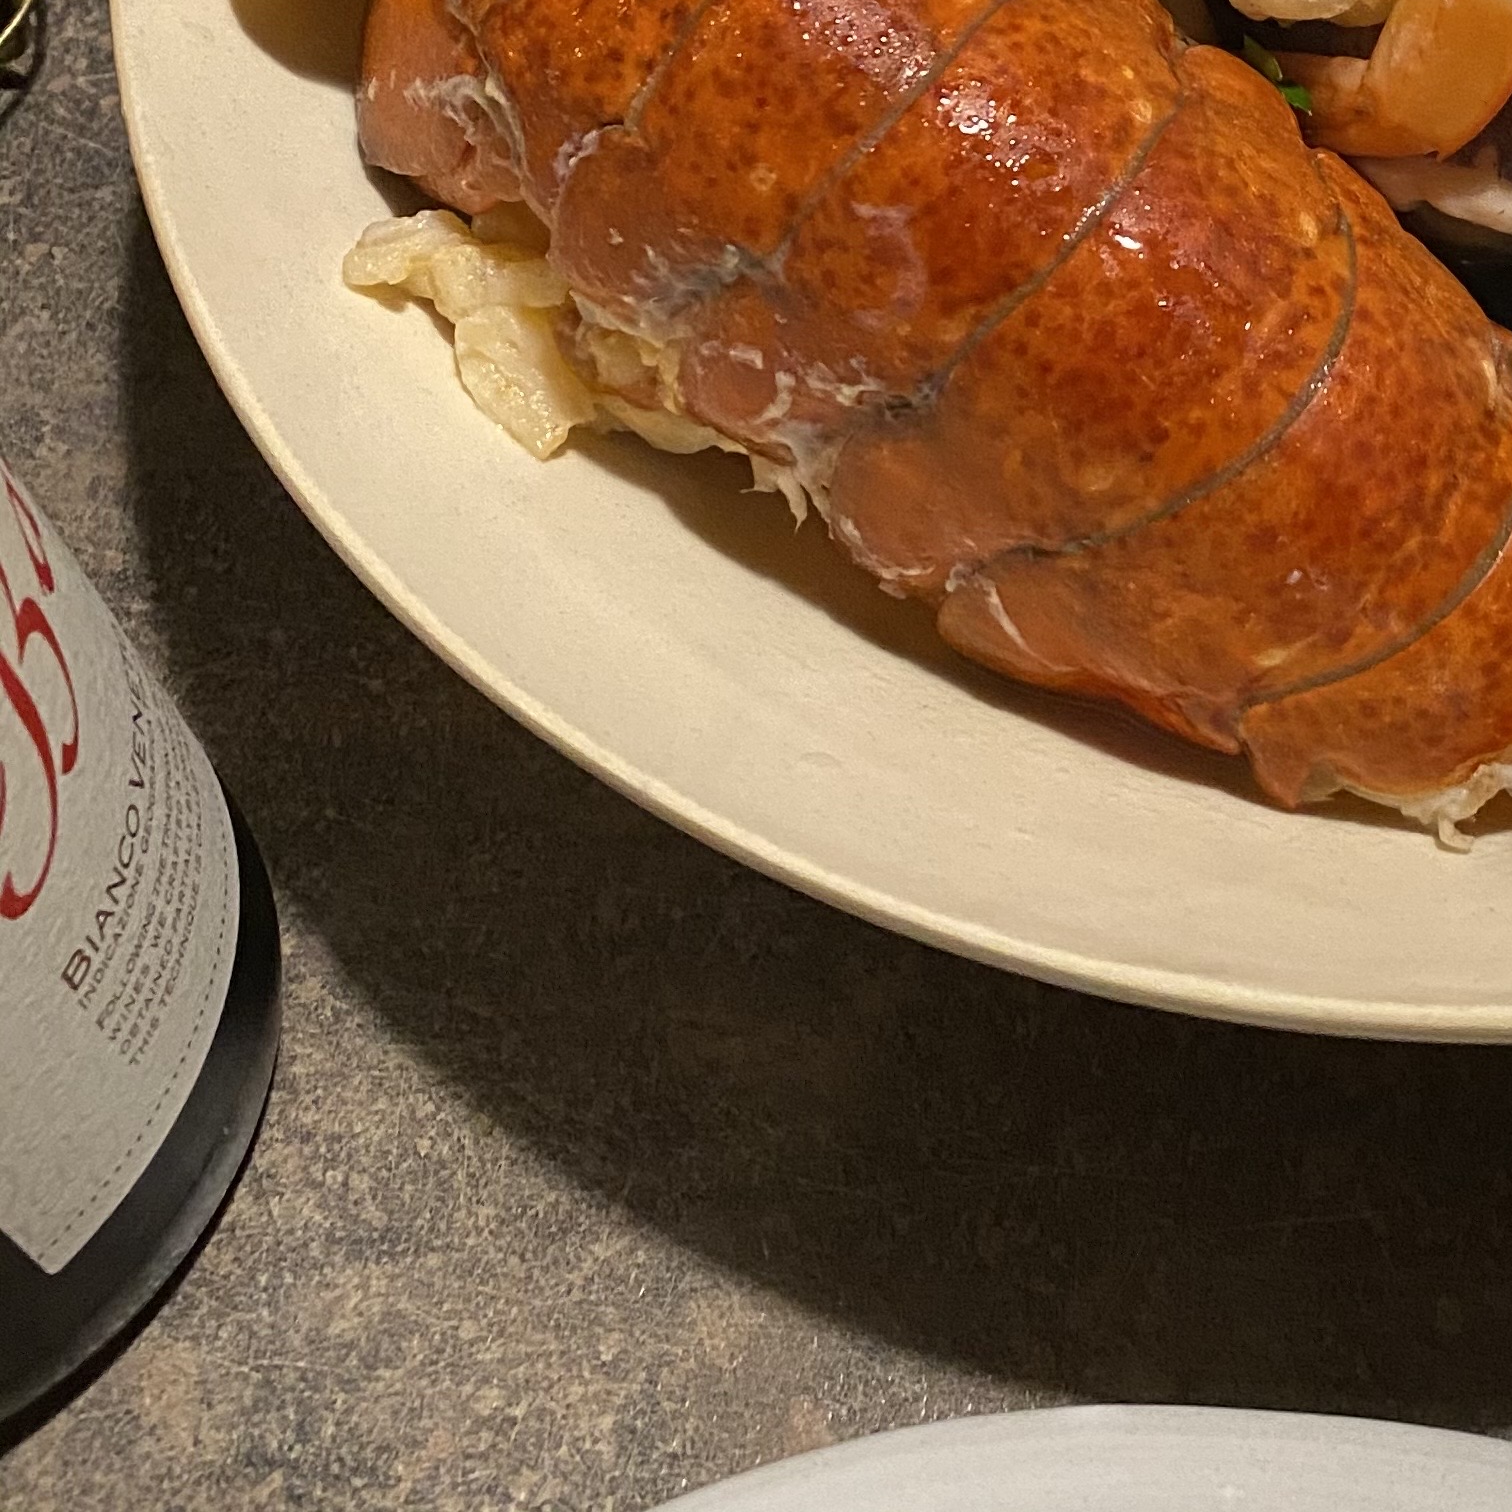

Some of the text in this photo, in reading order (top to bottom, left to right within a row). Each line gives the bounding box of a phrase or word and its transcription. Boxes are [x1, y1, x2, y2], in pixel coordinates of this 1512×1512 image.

[61, 804, 140, 990] BIANCO
[78, 860, 144, 1010] INDICAZIONE
[96, 902, 156, 1031] FOLLOWING
[109, 963, 151, 1041] WINES
[120, 940, 173, 1054] OBTAINED
